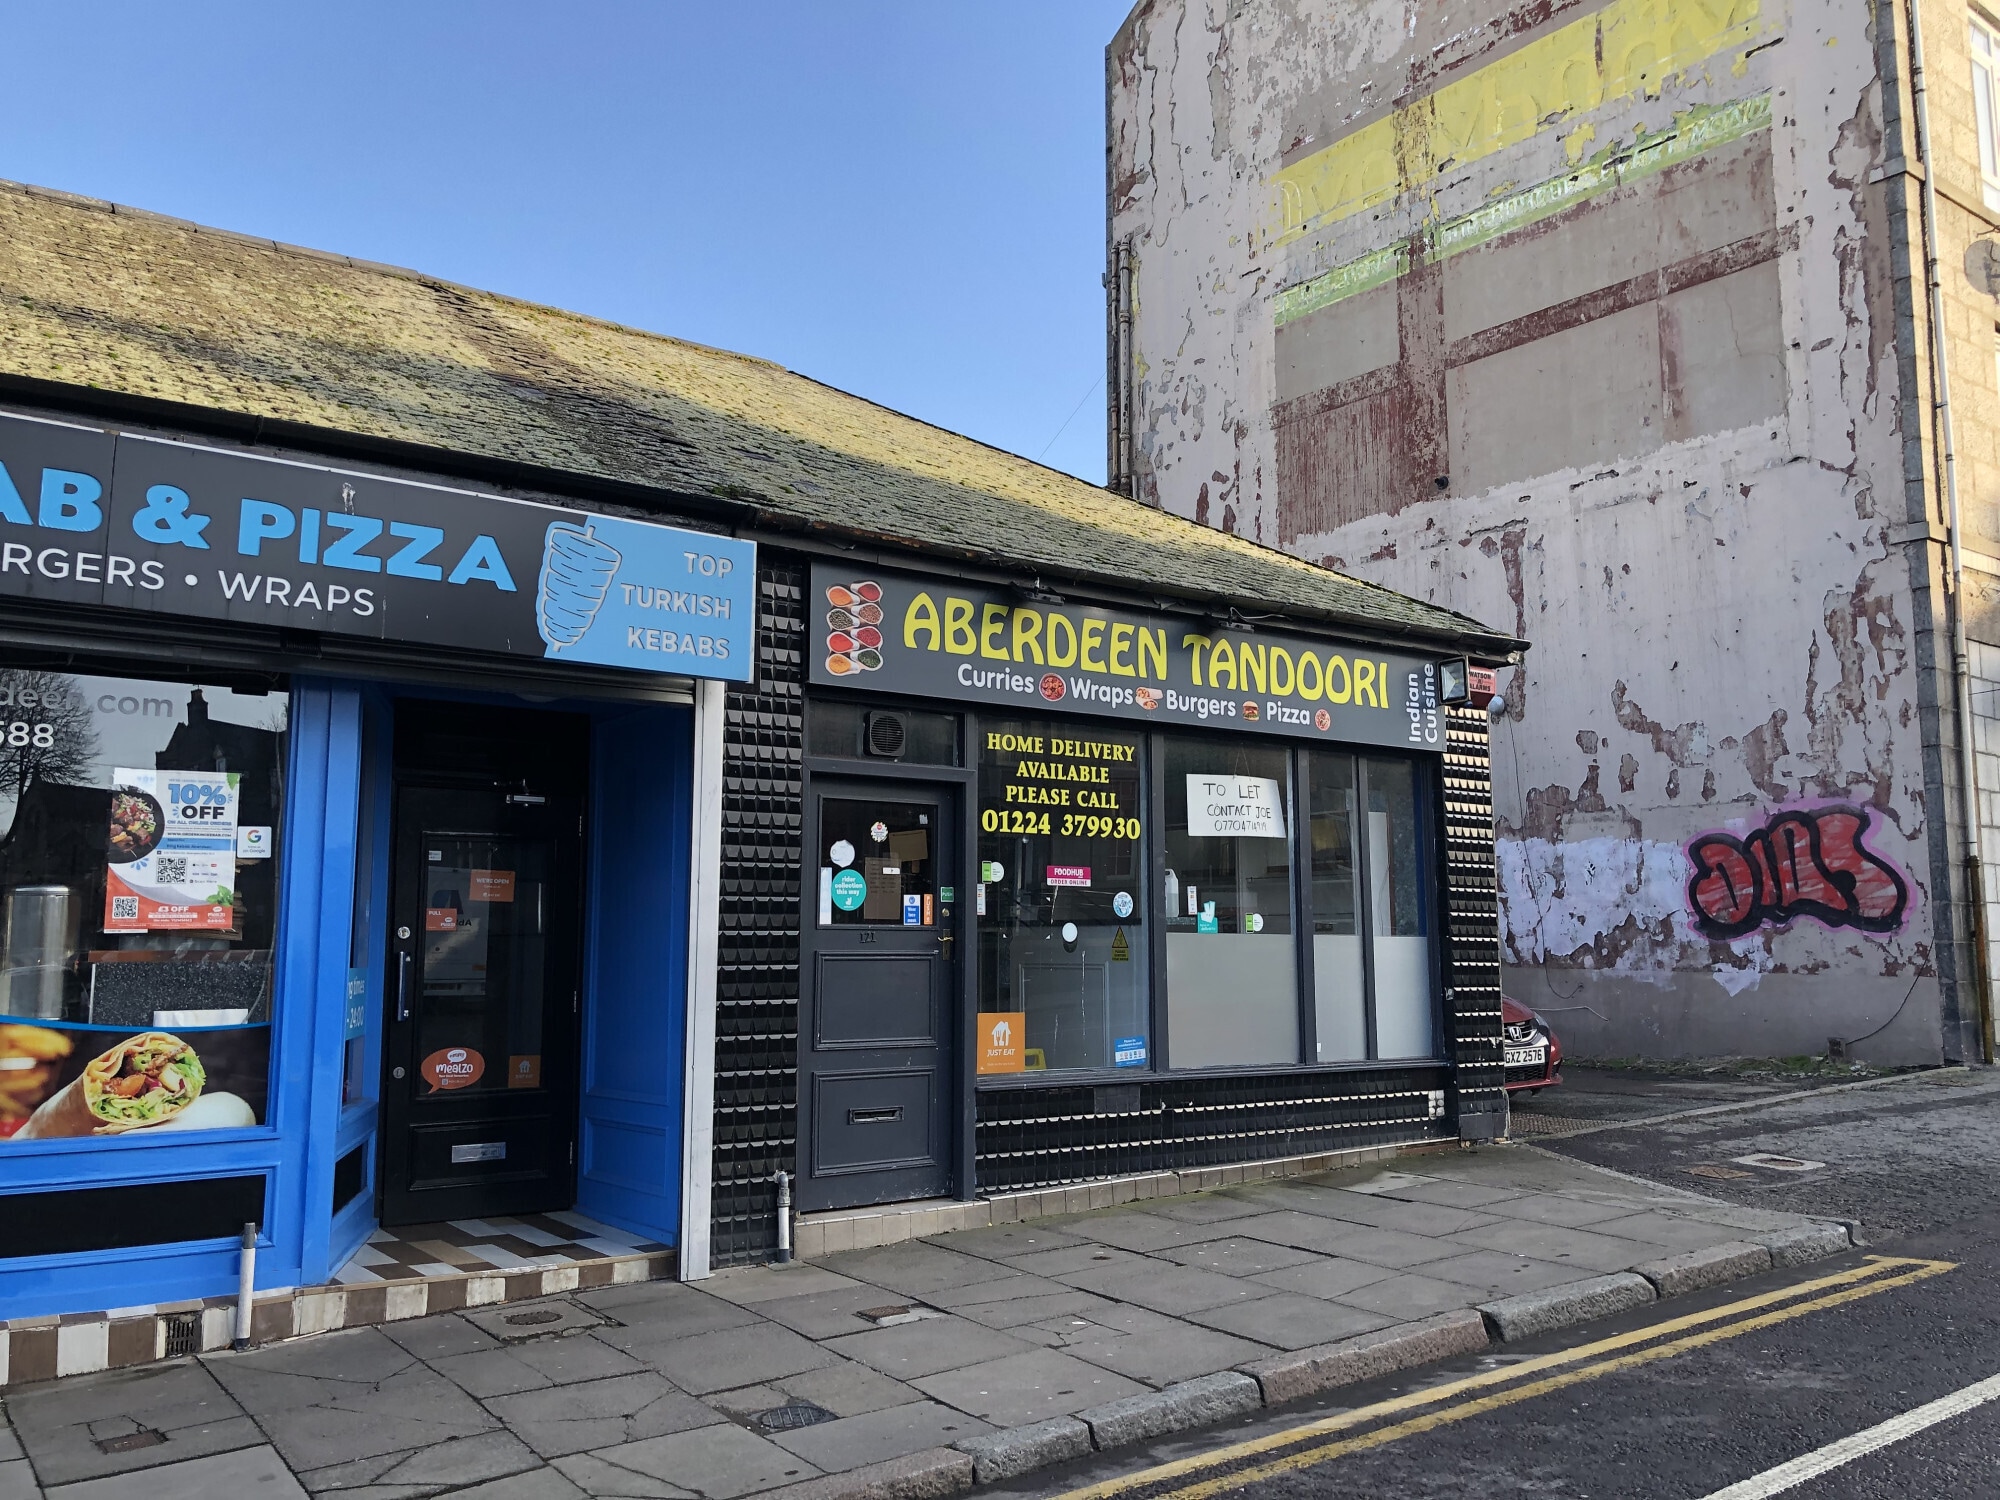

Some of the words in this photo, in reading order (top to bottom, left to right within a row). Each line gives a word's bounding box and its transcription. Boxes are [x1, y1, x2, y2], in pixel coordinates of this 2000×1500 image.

[132, 484, 211, 549] &
[238, 498, 517, 592] PIZZA
[684, 551, 734, 578] TOP
[2, 542, 165, 590] RGERS
[218, 571, 375, 616] WRAPS
[621, 583, 732, 619] TURKISH
[627, 626, 730, 660] KEBABS
[903, 592, 1168, 681] ABERDEEN
[1182, 634, 1389, 709] TANDOORI
[1469, 670, 1492, 680] WATSON
[957, 663, 1035, 693] Curries
[1070, 676, 1134, 709] Wraps
[1166, 690, 1236, 719] Burgers
[1266, 702, 1311, 725] Pizza
[1469, 683, 1491, 692] ALARMS
[1405, 673, 1422, 742] Indian
[1422, 663, 1438, 744] Cuisine
[0, 720, 54, 748] 88
[987, 732, 1044, 754] HOME
[1051, 738, 1135, 762] DELIVERY
[1016, 761, 1110, 784] AVAILABLE
[168, 783, 227, 806] 10%
[1005, 785, 1070, 806] PLEASE
[1077, 790, 1119, 809] CALL
[1202, 783, 1226, 797] TO
[1239, 784, 1260, 799] LET
[181, 805, 225, 819] OFF
[1206, 804, 1251, 817] CONTACT
[1255, 806, 1271, 819] JOE
[981, 809, 1051, 834] 01224
[1060, 813, 1141, 840] 379930
[1054, 868, 1084, 877] FOODHUB
[834, 882, 864, 890] collection
[987, 1049, 1002, 1057] JUST
[1523, 1049, 1542, 1062] 2576
[436, 1063, 474, 1074] mealzo
